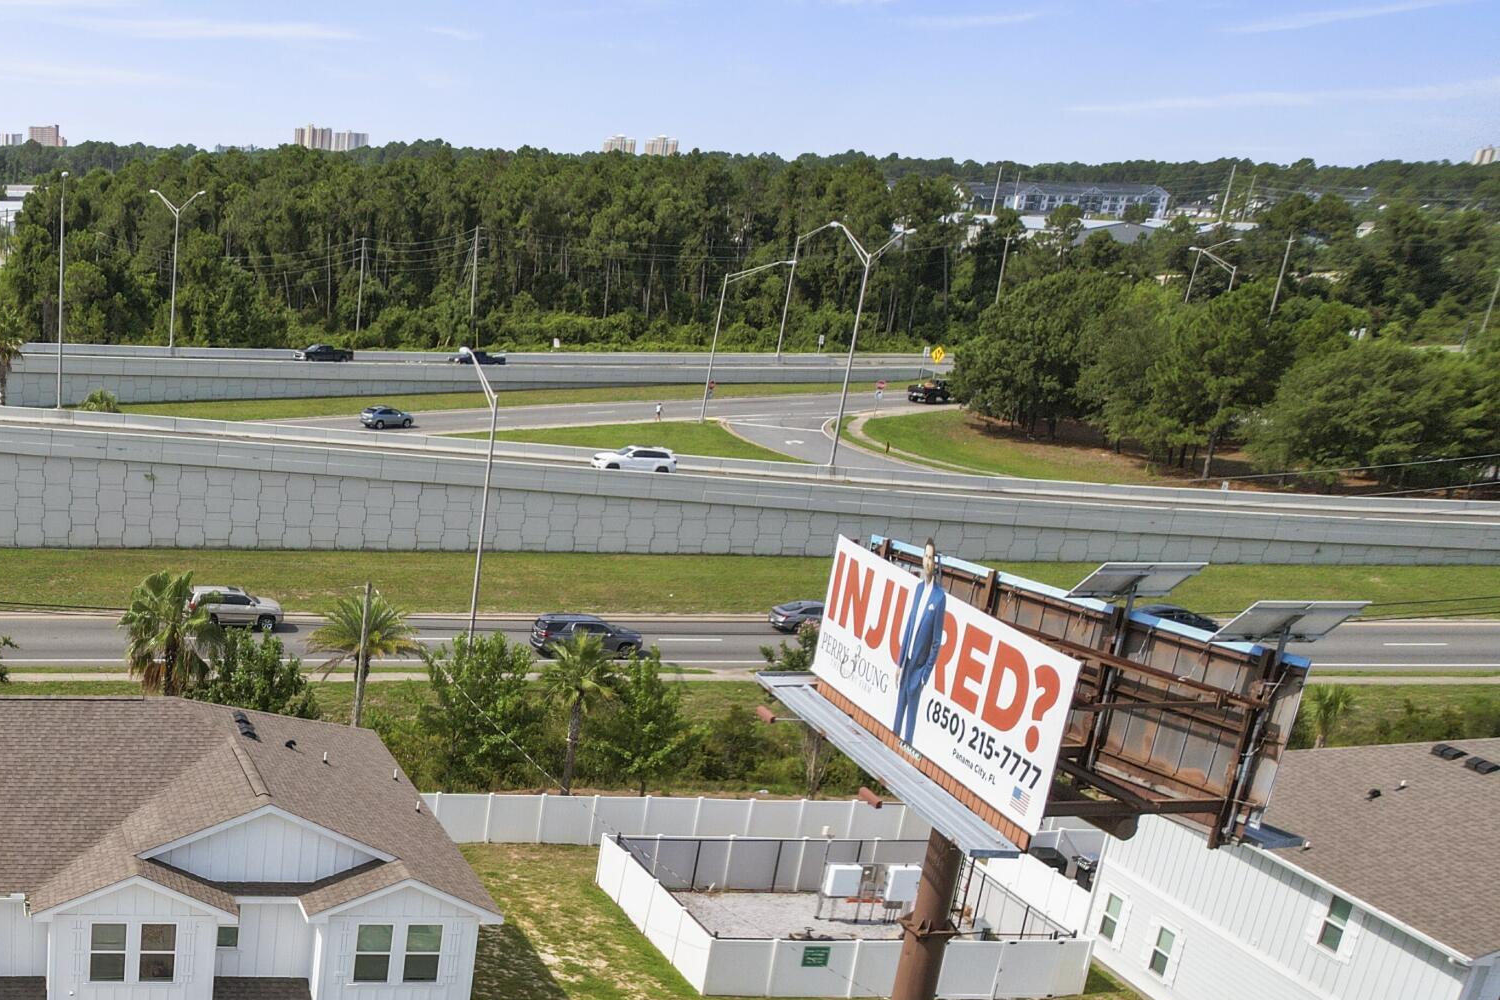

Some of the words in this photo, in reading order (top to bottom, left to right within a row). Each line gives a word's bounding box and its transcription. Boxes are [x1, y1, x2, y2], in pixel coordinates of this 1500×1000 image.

[926, 698, 965, 743] (850)
[967, 726, 1042, 790] 215-7777
[952, 747, 974, 770] Panama
[988, 774, 996, 785] FL
